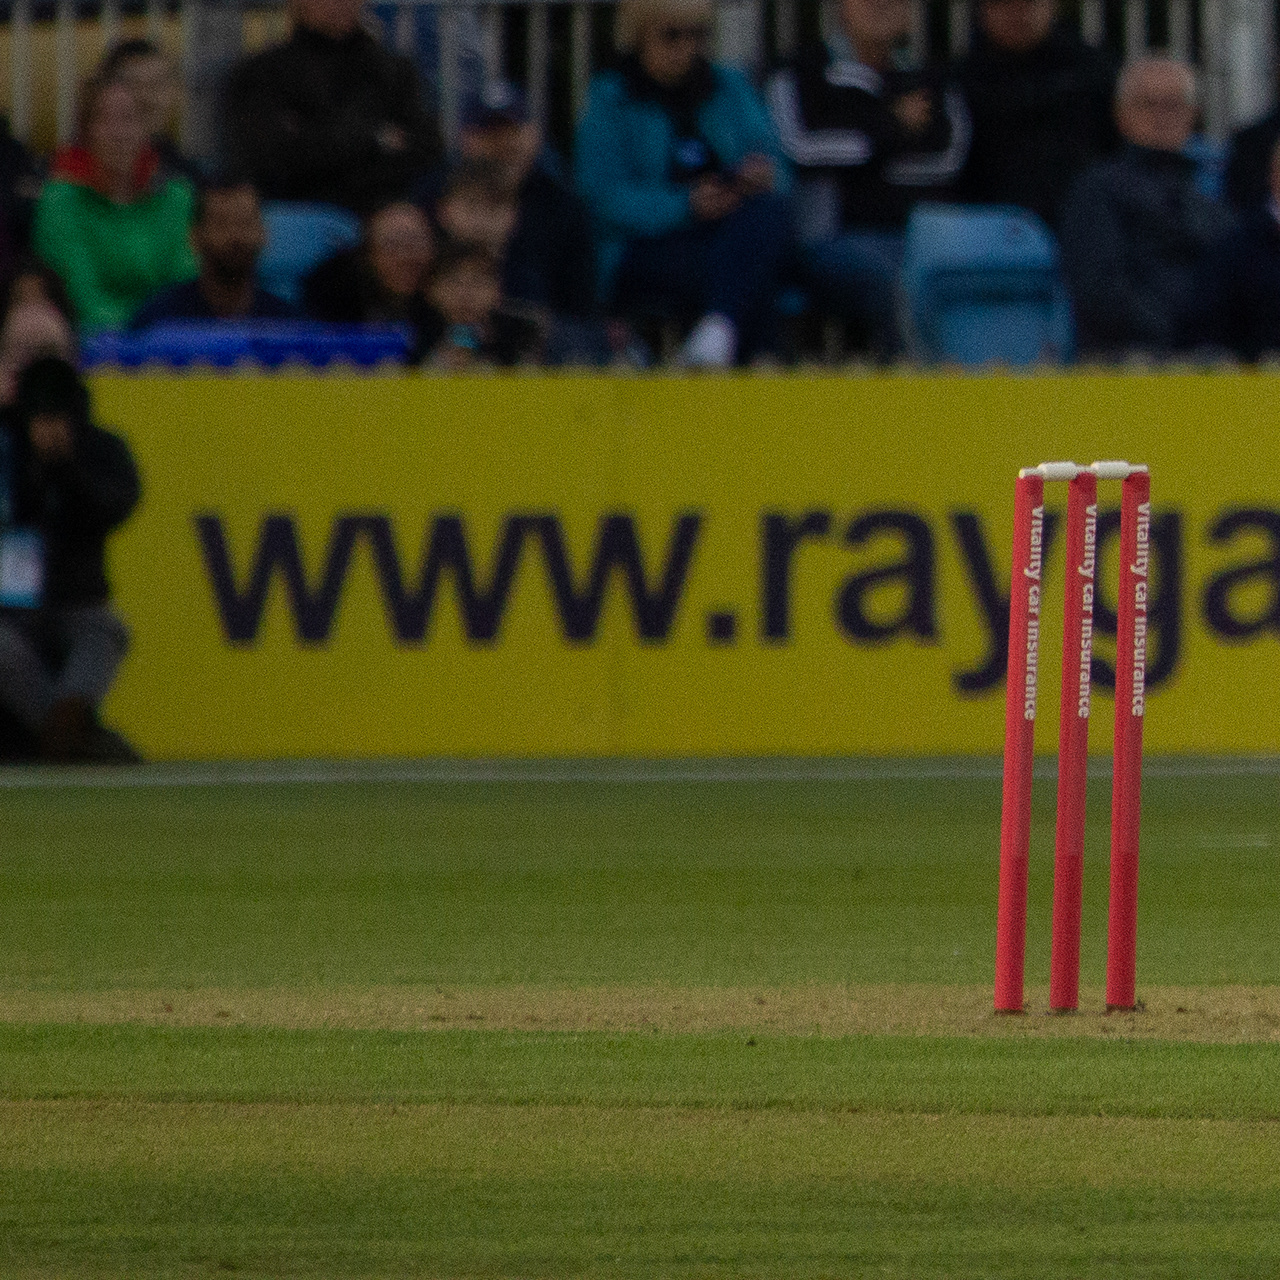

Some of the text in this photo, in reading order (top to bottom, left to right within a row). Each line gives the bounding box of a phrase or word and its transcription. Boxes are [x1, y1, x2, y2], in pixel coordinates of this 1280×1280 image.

[1028, 585, 1041, 616] car
[1082, 582, 1094, 614] car
[1134, 581, 1147, 612] car
[1024, 620, 1040, 720] insurance
[1077, 618, 1093, 719] insurance
[1131, 617, 1148, 717] insurance
